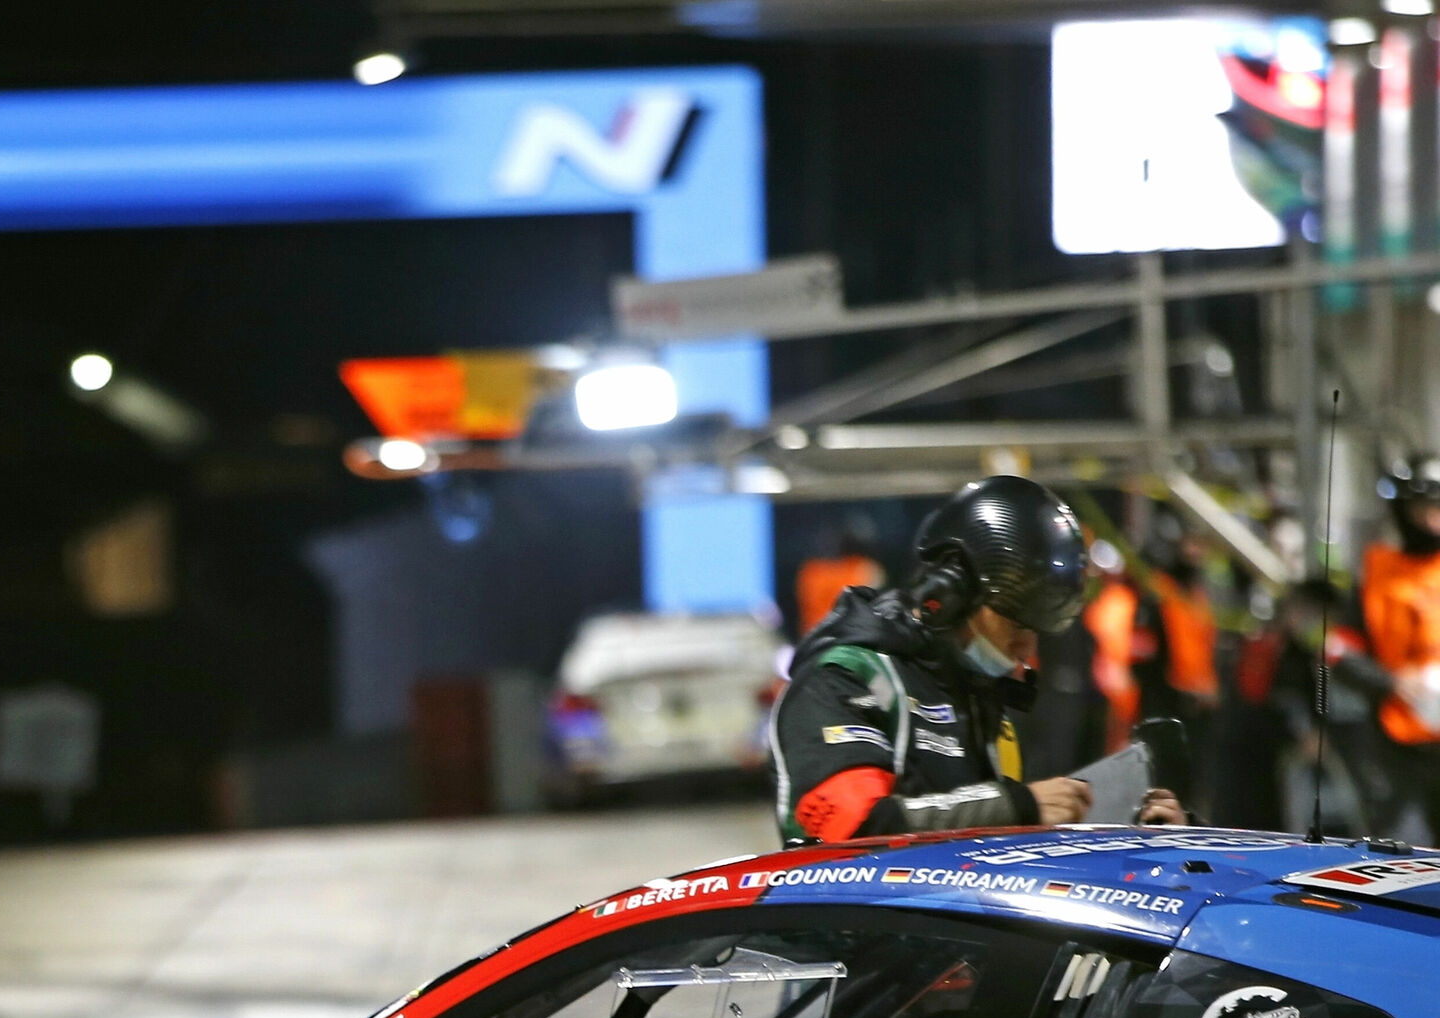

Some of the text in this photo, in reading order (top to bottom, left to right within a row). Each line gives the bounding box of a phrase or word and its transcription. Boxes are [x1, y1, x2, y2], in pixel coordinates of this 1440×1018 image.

[767, 866, 877, 888] GOUNON
[911, 867, 1038, 894] SCHRAMM
[626, 876, 729, 910] BERETTA
[1069, 883, 1184, 915] STIPPLER
